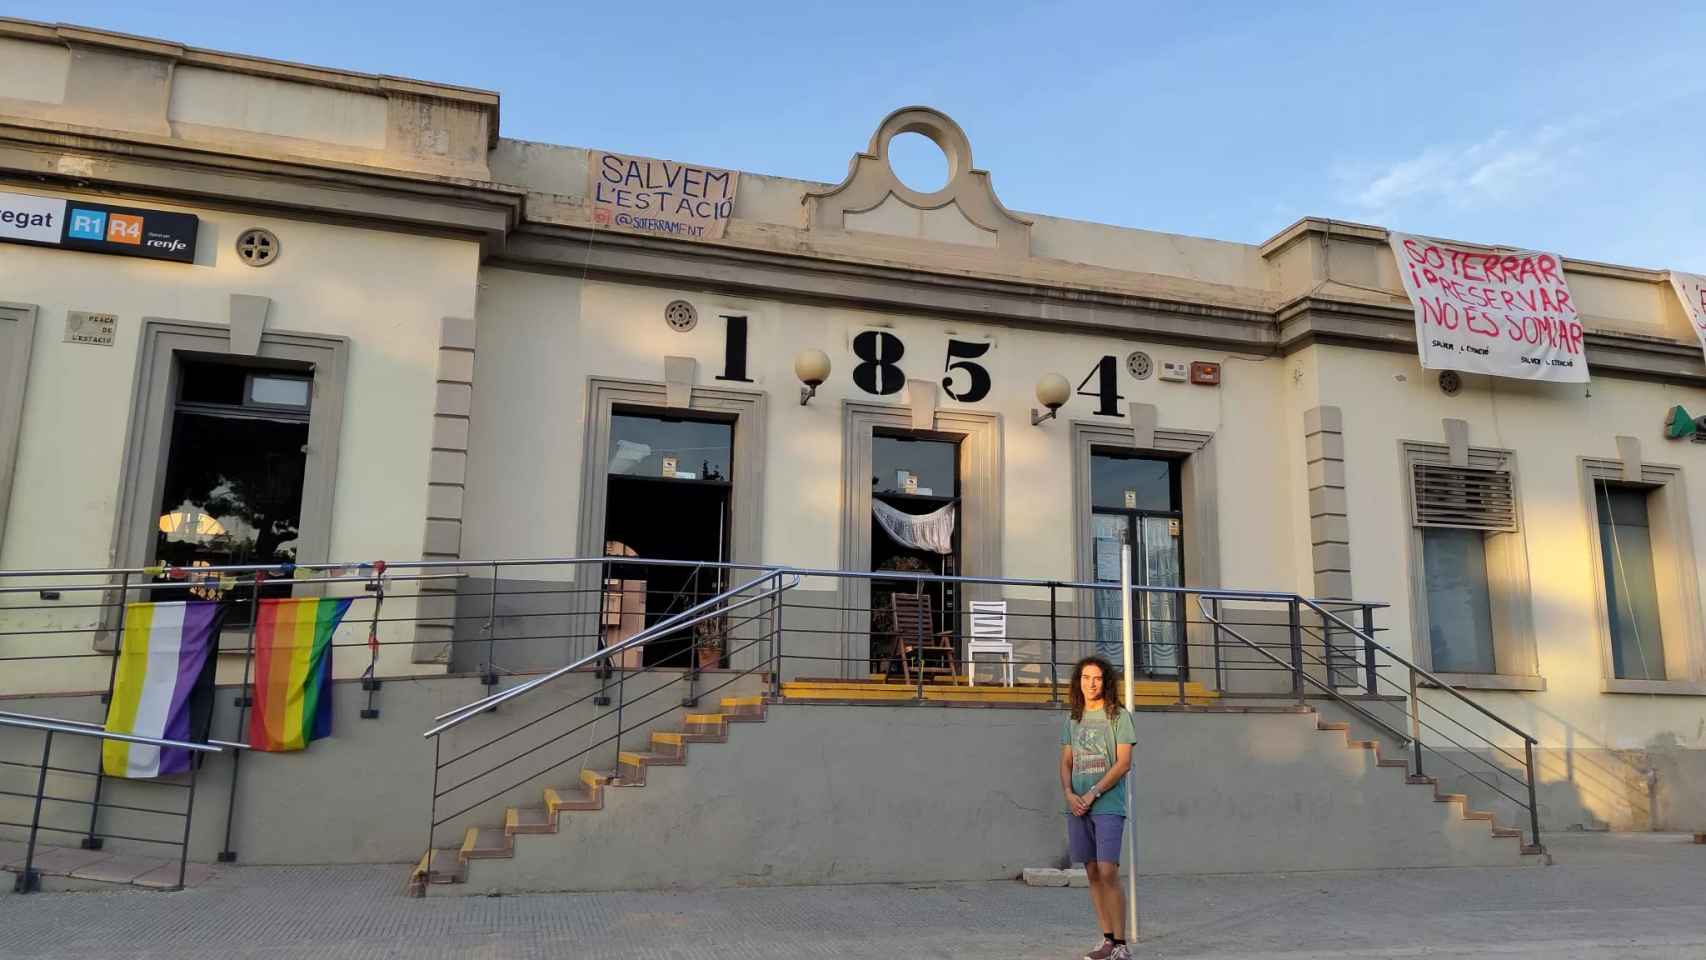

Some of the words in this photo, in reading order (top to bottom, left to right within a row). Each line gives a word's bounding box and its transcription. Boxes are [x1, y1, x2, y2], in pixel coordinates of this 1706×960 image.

[602, 155, 730, 200] SALVEM
[0, 209, 53, 228] egat
[595, 182, 733, 220] L'ESTACIÓ
[74, 215, 101, 233] R1
[110, 219, 140, 238] R4
[147, 239, 187, 252] renfe
[1403, 240, 1564, 286] SOTERRAR
[1423, 269, 1576, 314] PRESERVAR
[1419, 296, 1459, 331] NO
[715, 314, 754, 383] 1
[852, 330, 906, 396] 8
[942, 338, 992, 403] 5
[1077, 354, 1125, 418] 4
